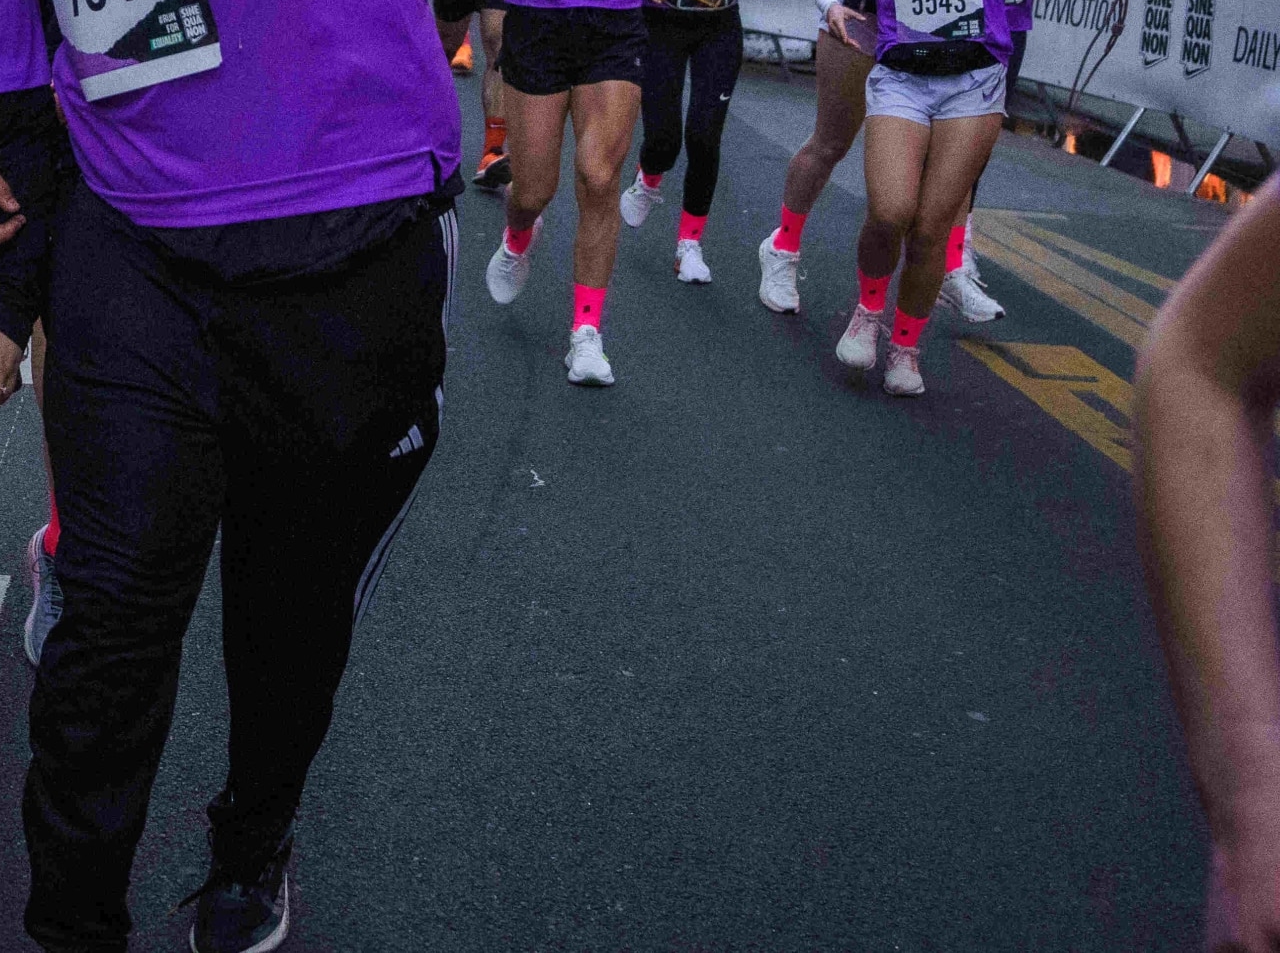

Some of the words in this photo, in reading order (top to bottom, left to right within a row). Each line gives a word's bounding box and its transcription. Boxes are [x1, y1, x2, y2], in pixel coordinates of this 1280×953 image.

[180, 5, 201, 18] SINE
[183, 15, 203, 28] QUA
[1145, 7, 1169, 31] QUA
[186, 24, 206, 38] NON
[1186, 16, 1211, 41] QUA
[1142, 32, 1168, 57] NON
[1182, 40, 1210, 66] NON
